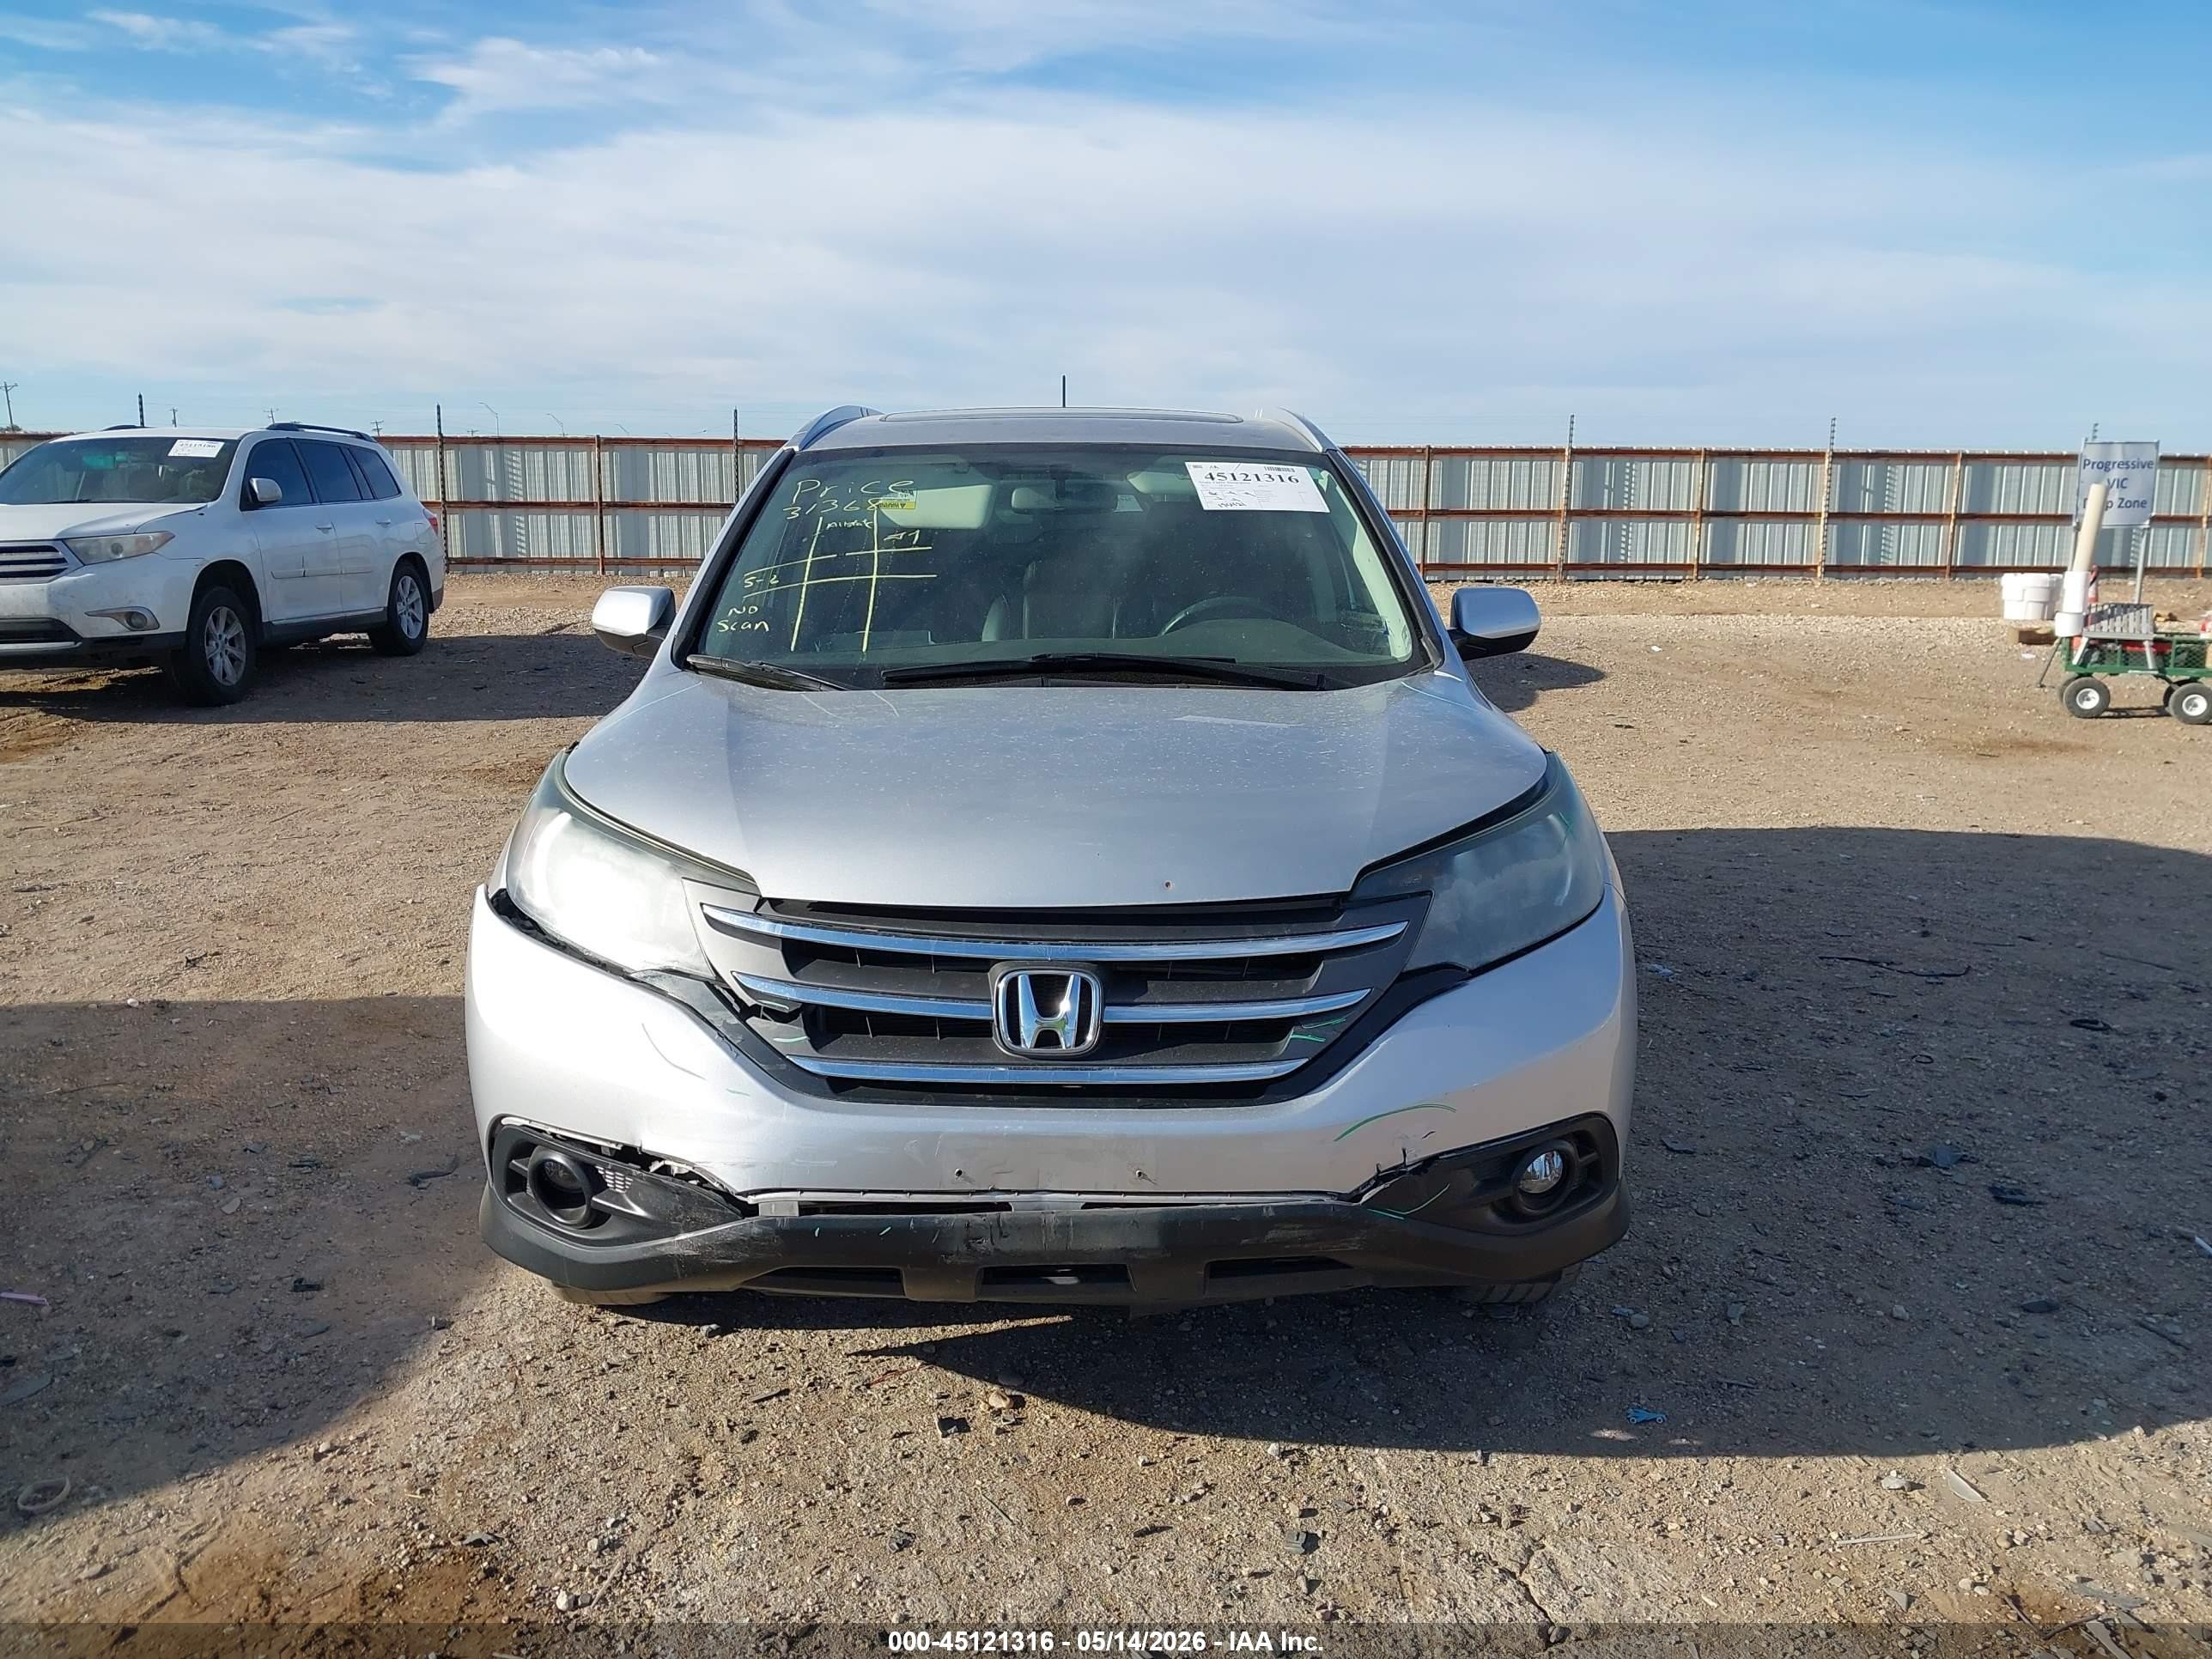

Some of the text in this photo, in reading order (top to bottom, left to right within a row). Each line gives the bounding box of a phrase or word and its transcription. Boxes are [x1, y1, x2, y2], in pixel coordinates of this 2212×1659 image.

[2082, 458, 2154, 472] Progressive
[1205, 471, 1299, 483] 45121316
[2107, 477, 2129, 489] VIC
[2118, 497, 2148, 509] Zone
